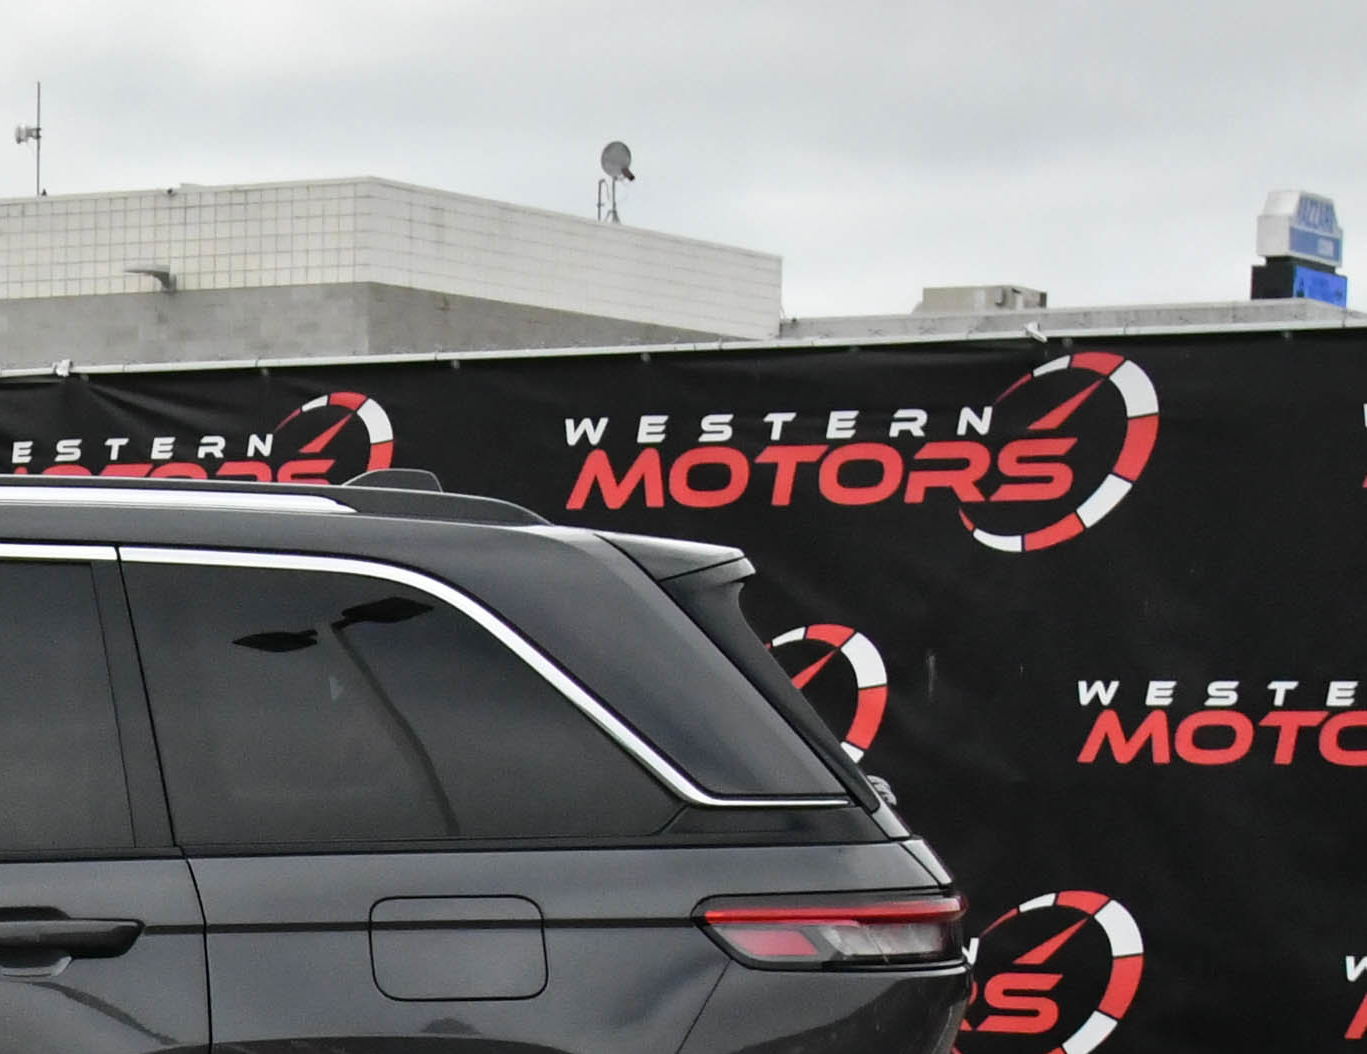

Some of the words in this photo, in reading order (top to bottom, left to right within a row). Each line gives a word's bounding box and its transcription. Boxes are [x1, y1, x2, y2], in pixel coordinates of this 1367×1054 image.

[565, 406, 994, 446] WESTERN
[566, 437, 1079, 510] MOTORS
[1077, 680, 1359, 707] WESTE
